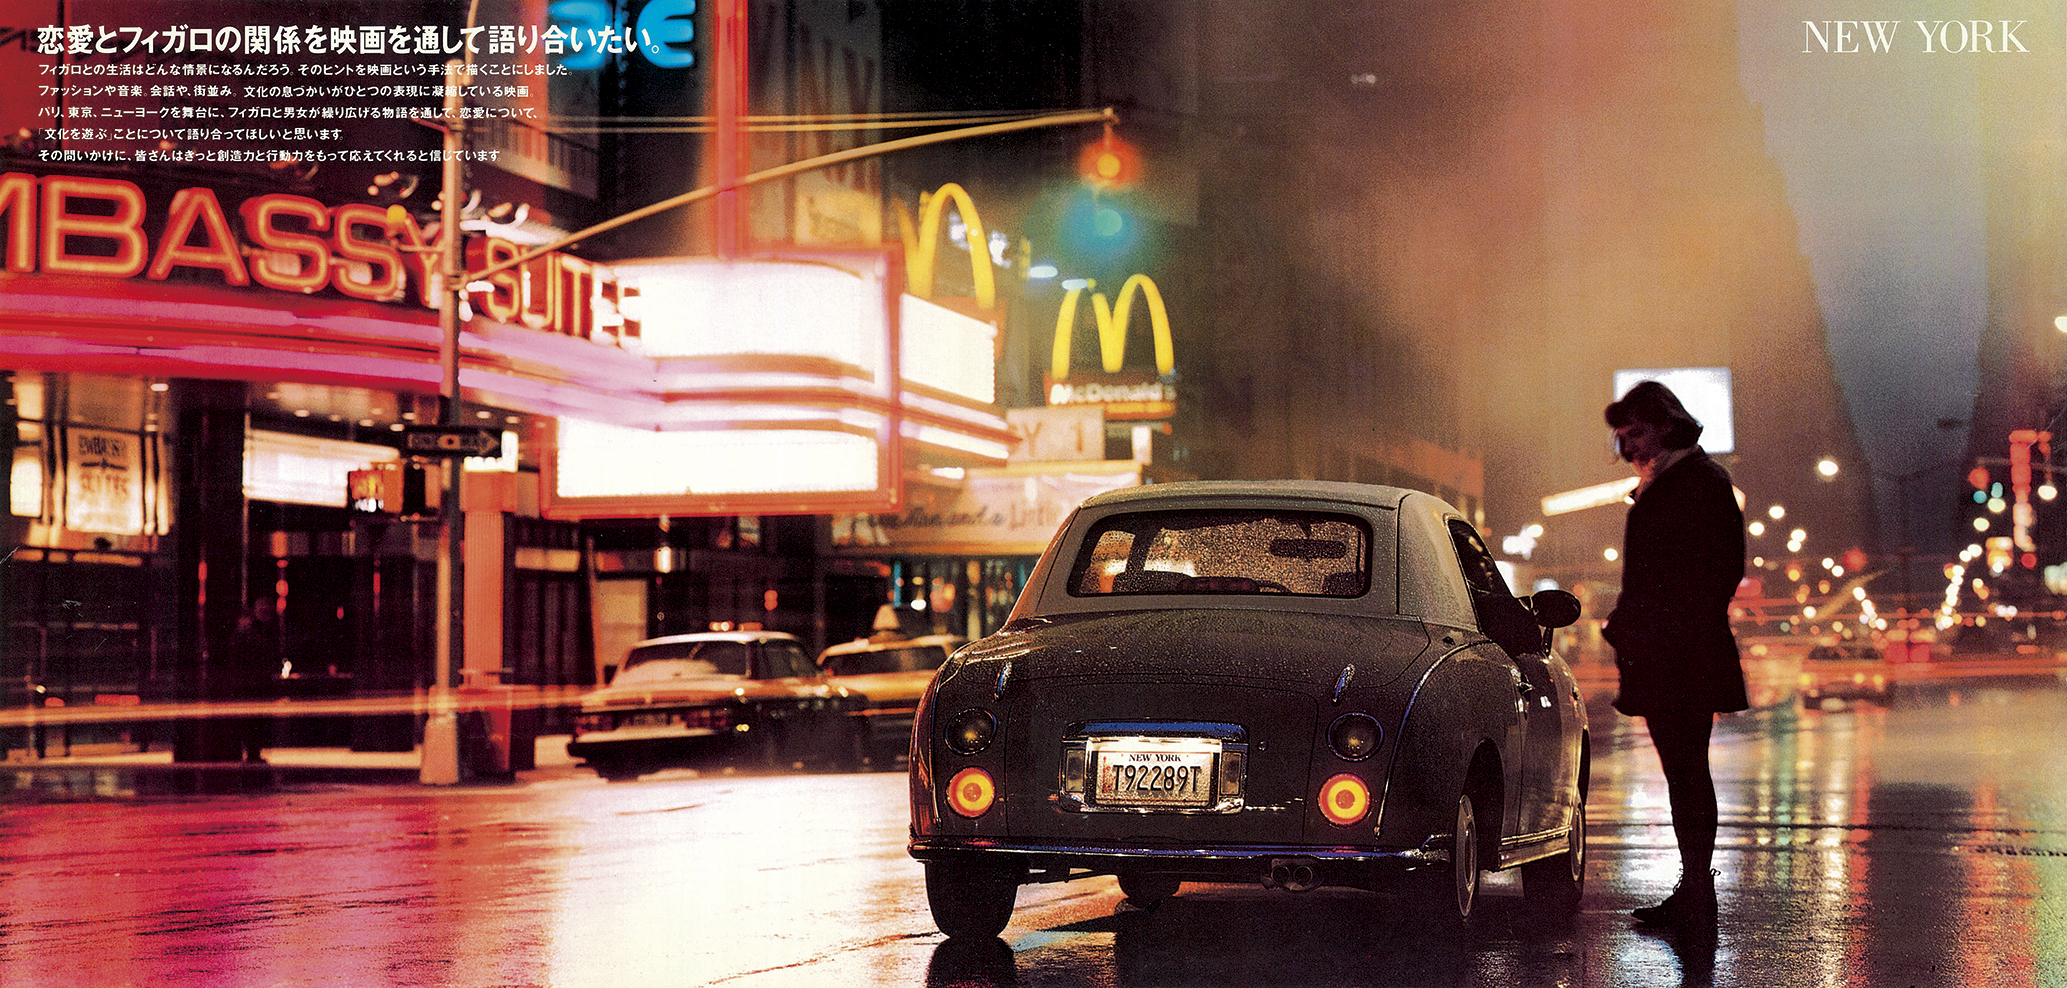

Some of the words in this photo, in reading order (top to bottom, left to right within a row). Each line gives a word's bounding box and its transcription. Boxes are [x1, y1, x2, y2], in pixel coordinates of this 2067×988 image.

[1050, 382, 1177, 405] McDonald's
[1128, 753, 1151, 763] NEW
[1154, 753, 1182, 763] YORK
[1112, 764, 1202, 792] T92289T
